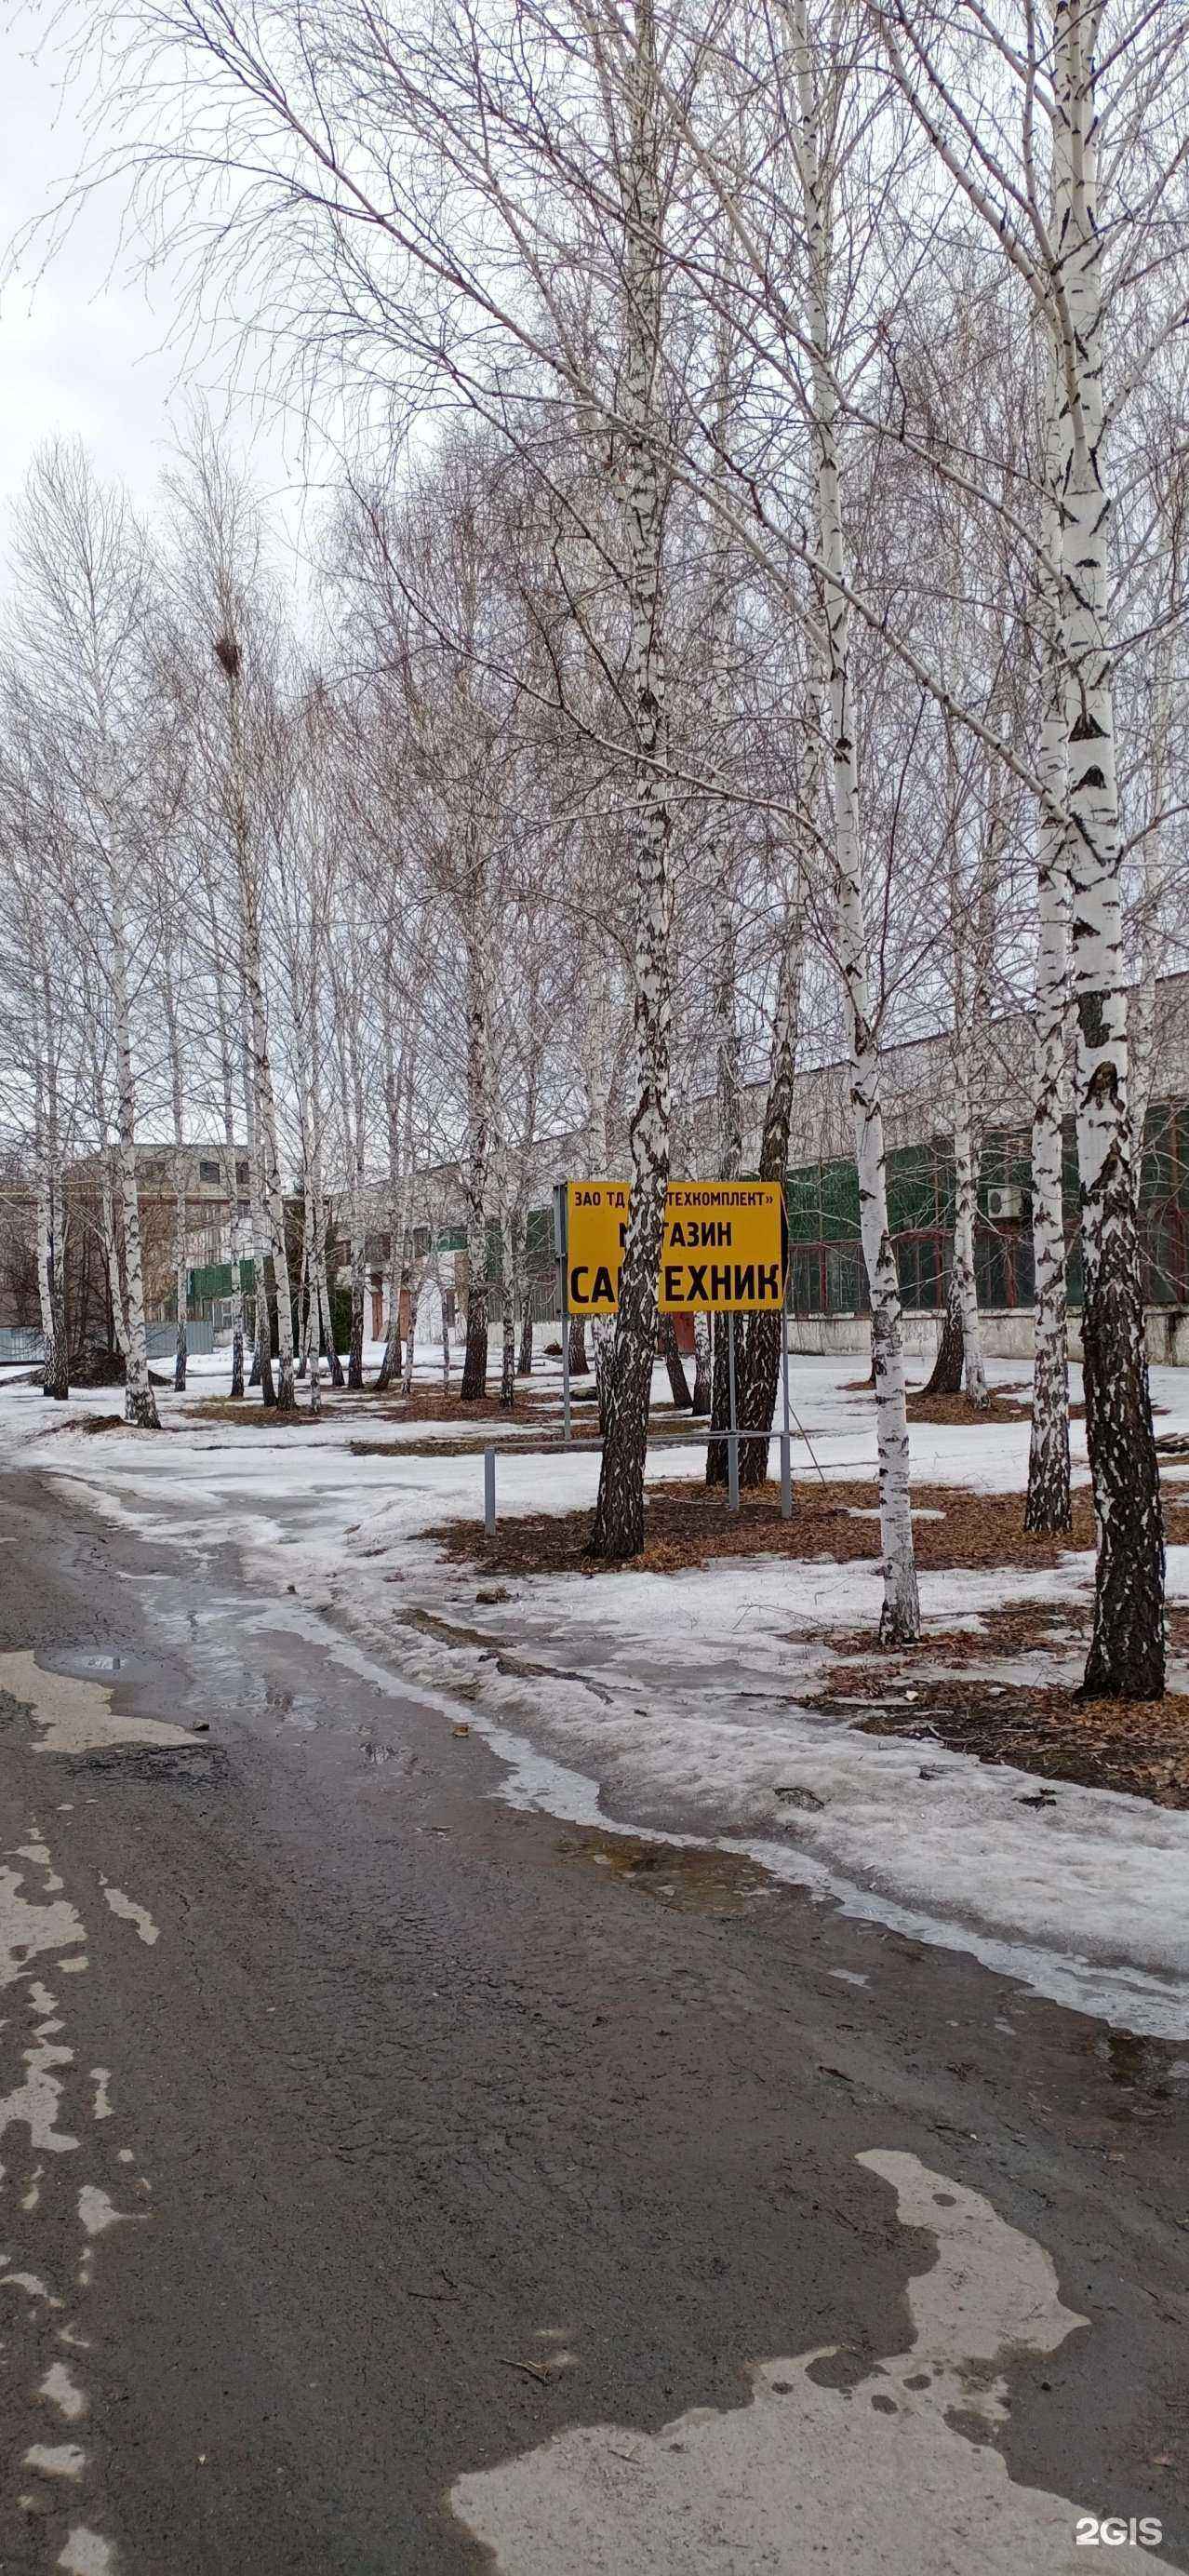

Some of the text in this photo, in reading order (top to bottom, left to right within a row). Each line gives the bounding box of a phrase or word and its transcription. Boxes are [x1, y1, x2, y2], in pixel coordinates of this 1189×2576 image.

[575, 1191, 773, 1209] ЗАО ТД ТЕХКОМПЛЕКТ»
[620, 1222, 732, 1247] АЗИН
[570, 1265, 779, 1303] САЕХНИК
